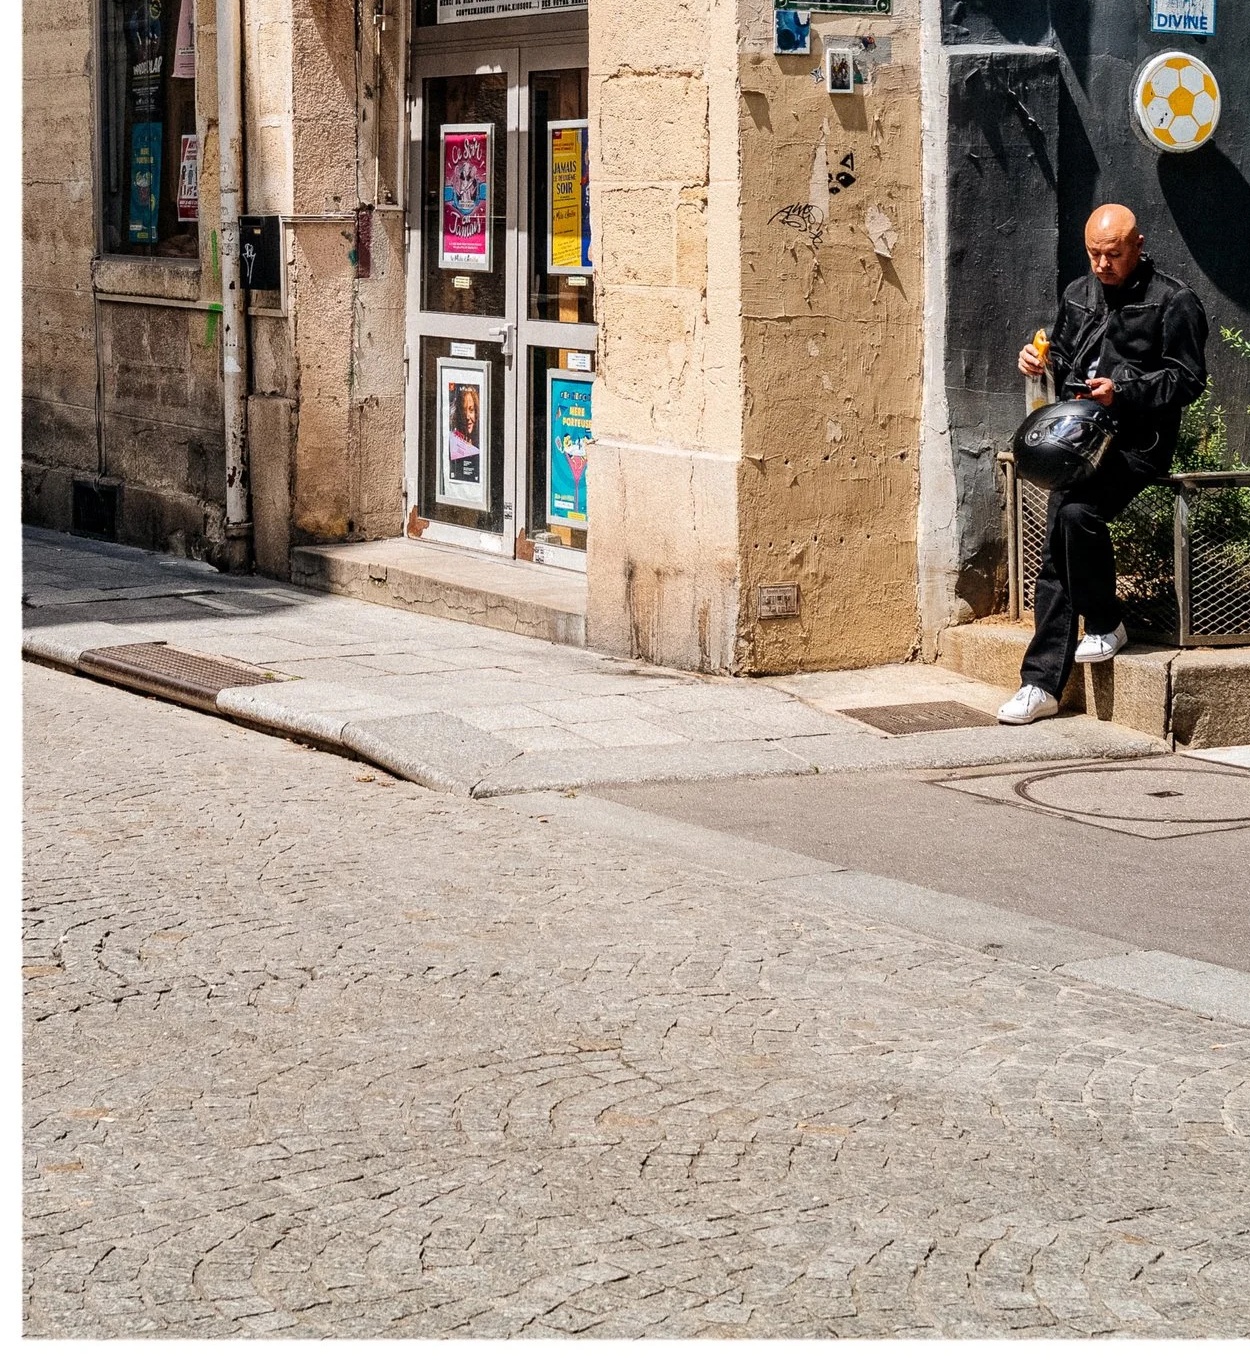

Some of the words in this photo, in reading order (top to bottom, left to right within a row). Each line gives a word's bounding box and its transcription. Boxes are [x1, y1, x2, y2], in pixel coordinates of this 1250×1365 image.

[1157, 13, 1208, 31] DIVINE
[553, 160, 577, 174] JAMAIS
[556, 181, 573, 195] SOIR
